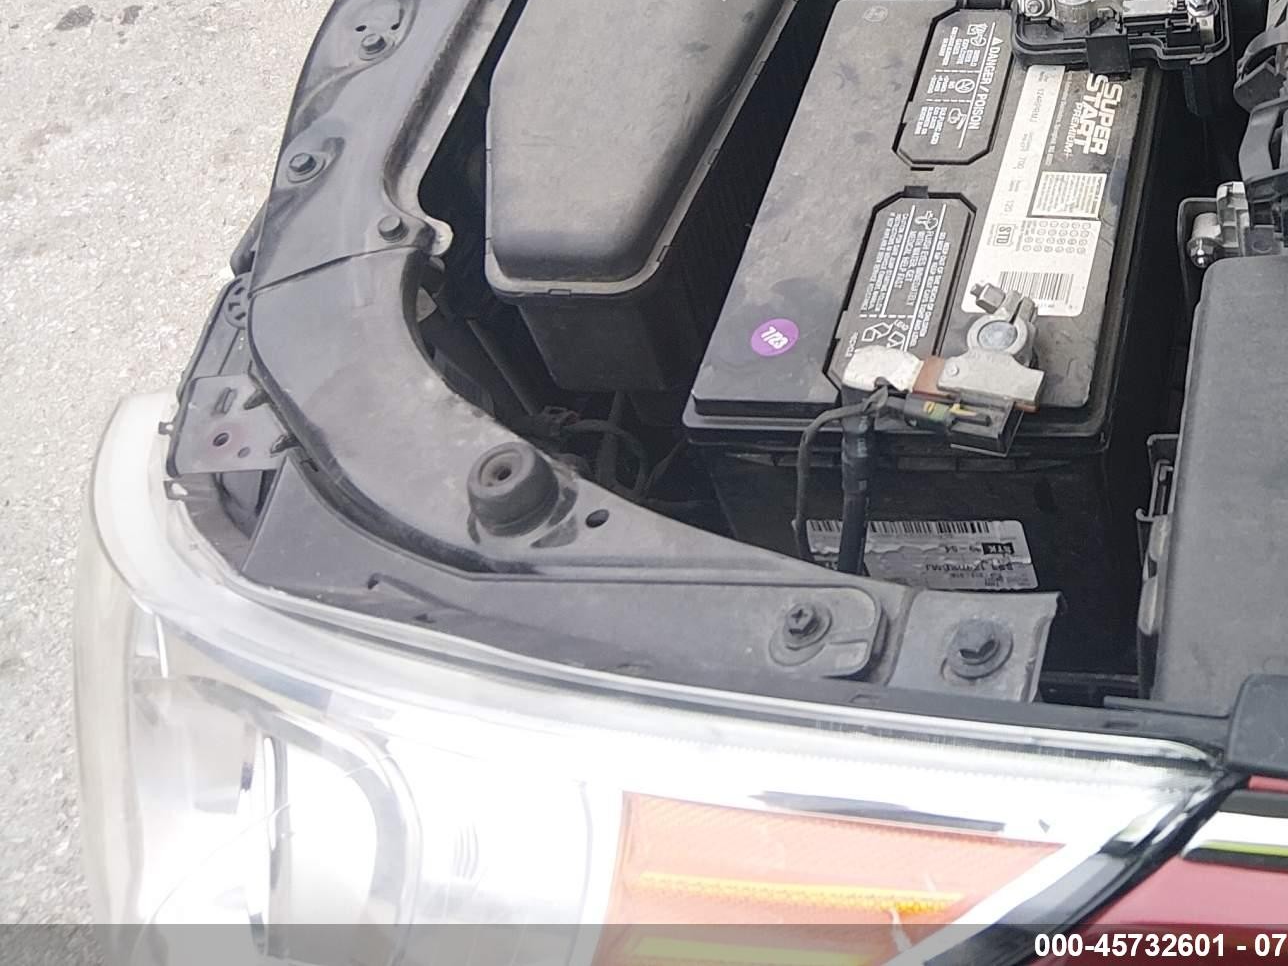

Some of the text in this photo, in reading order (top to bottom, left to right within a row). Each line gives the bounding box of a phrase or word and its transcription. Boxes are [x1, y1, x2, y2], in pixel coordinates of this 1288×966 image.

[980, 47, 1000, 85] DANGER
[968, 94, 988, 130] POISON
[1074, 73, 1109, 154] START
[1090, 84, 1123, 155] SUPER
[893, 230, 917, 288] MEDICAL HELP FAST
[914, 231, 925, 247] WITH
[996, 226, 1012, 245] STD
[905, 230, 934, 305] FLUSH EYES IMMEDIATELY
